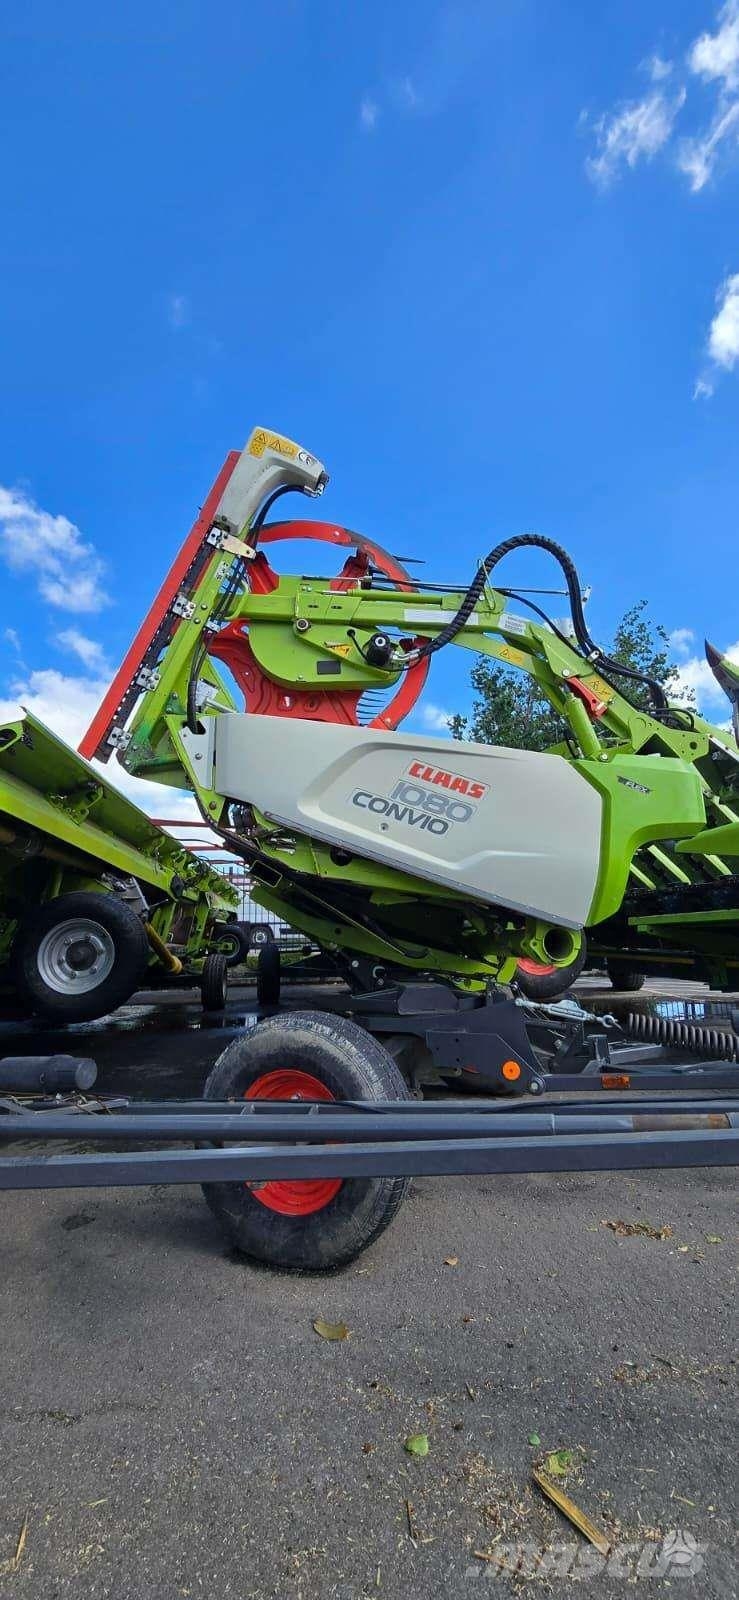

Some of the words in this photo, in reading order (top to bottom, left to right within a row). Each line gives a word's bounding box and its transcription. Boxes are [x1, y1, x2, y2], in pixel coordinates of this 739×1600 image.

[408, 762, 486, 799] CLAAS
[352, 791, 449, 835] CONVIO
[390, 782, 474, 823] 1080
